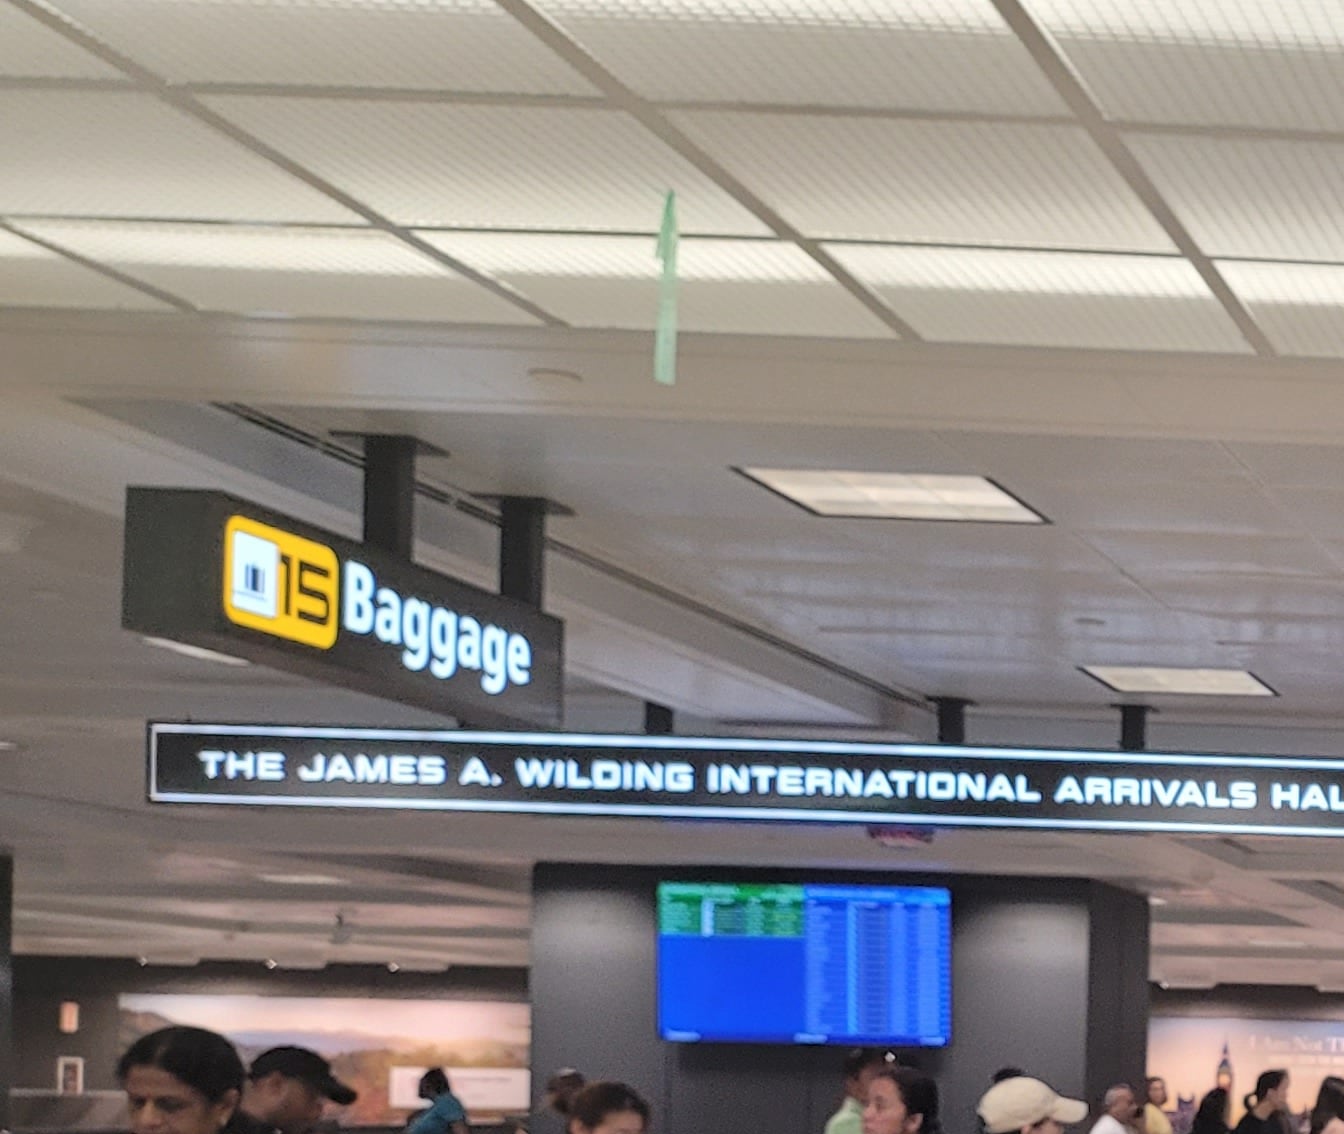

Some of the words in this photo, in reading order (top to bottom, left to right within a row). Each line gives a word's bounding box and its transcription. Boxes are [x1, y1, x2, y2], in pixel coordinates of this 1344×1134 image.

[281, 553, 331, 626] 15
[344, 560, 532, 695] Baggage
[198, 750, 285, 781] THE
[297, 753, 446, 785] JAMES
[458, 756, 502, 787] A.
[514, 757, 694, 793] WILDING
[706, 763, 1042, 803] INTERNATIONAL
[1054, 775, 1257, 809] ARRIVALS
